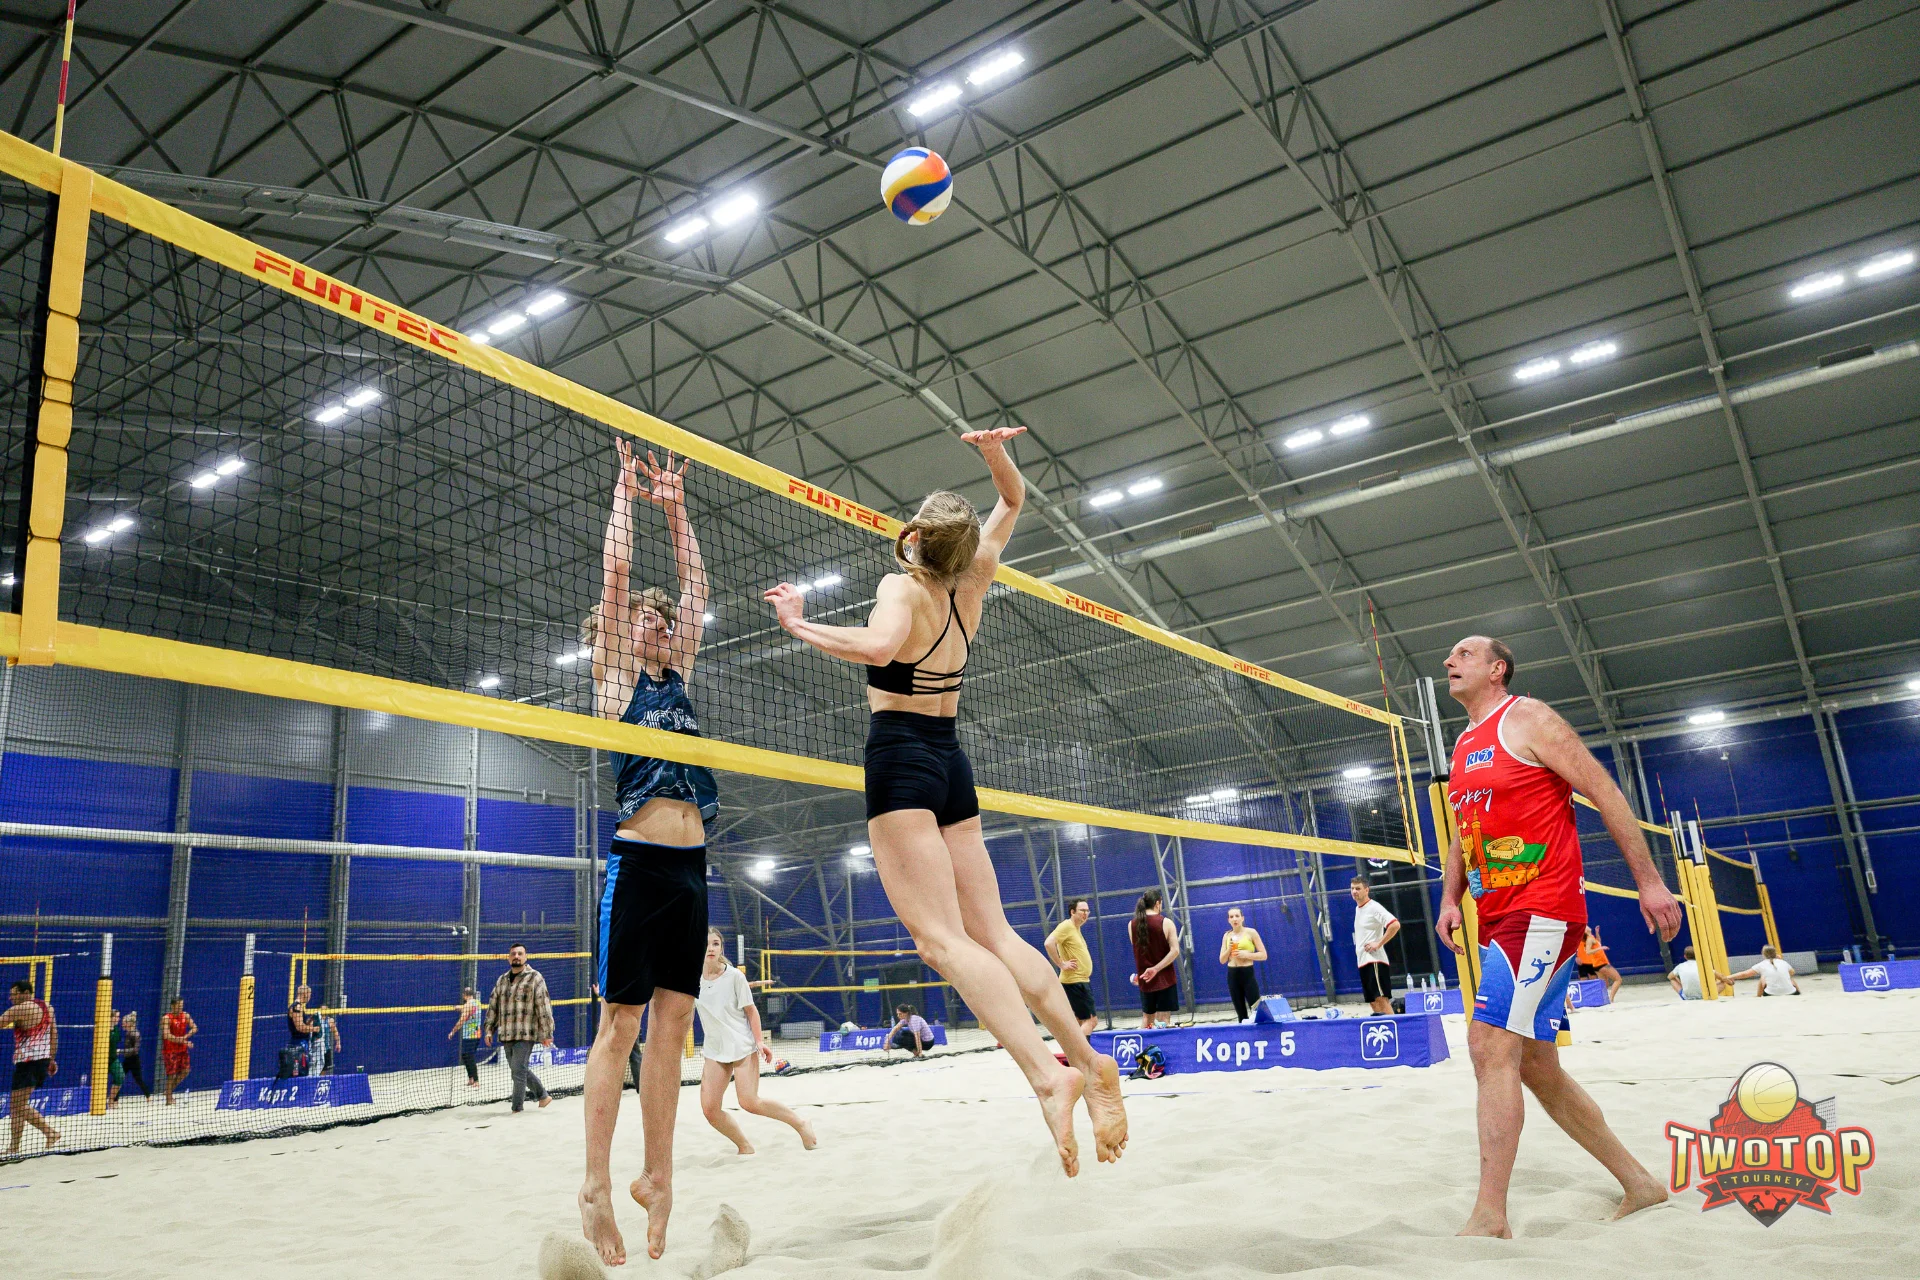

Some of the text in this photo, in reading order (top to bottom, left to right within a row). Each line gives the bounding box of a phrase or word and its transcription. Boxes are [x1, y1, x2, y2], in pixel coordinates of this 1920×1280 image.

[254, 250, 459, 355] FUNTEC
[788, 479, 889, 532] FUNTEC
[1065, 594, 1124, 625] FUNTEC
[1233, 660, 1272, 682] FUNTEC
[247, 985, 255, 1000] 2
[855, 1034, 882, 1048] Корт
[1196, 1031, 1296, 1066] Корт 5
[288, 1085, 299, 1101] 2
